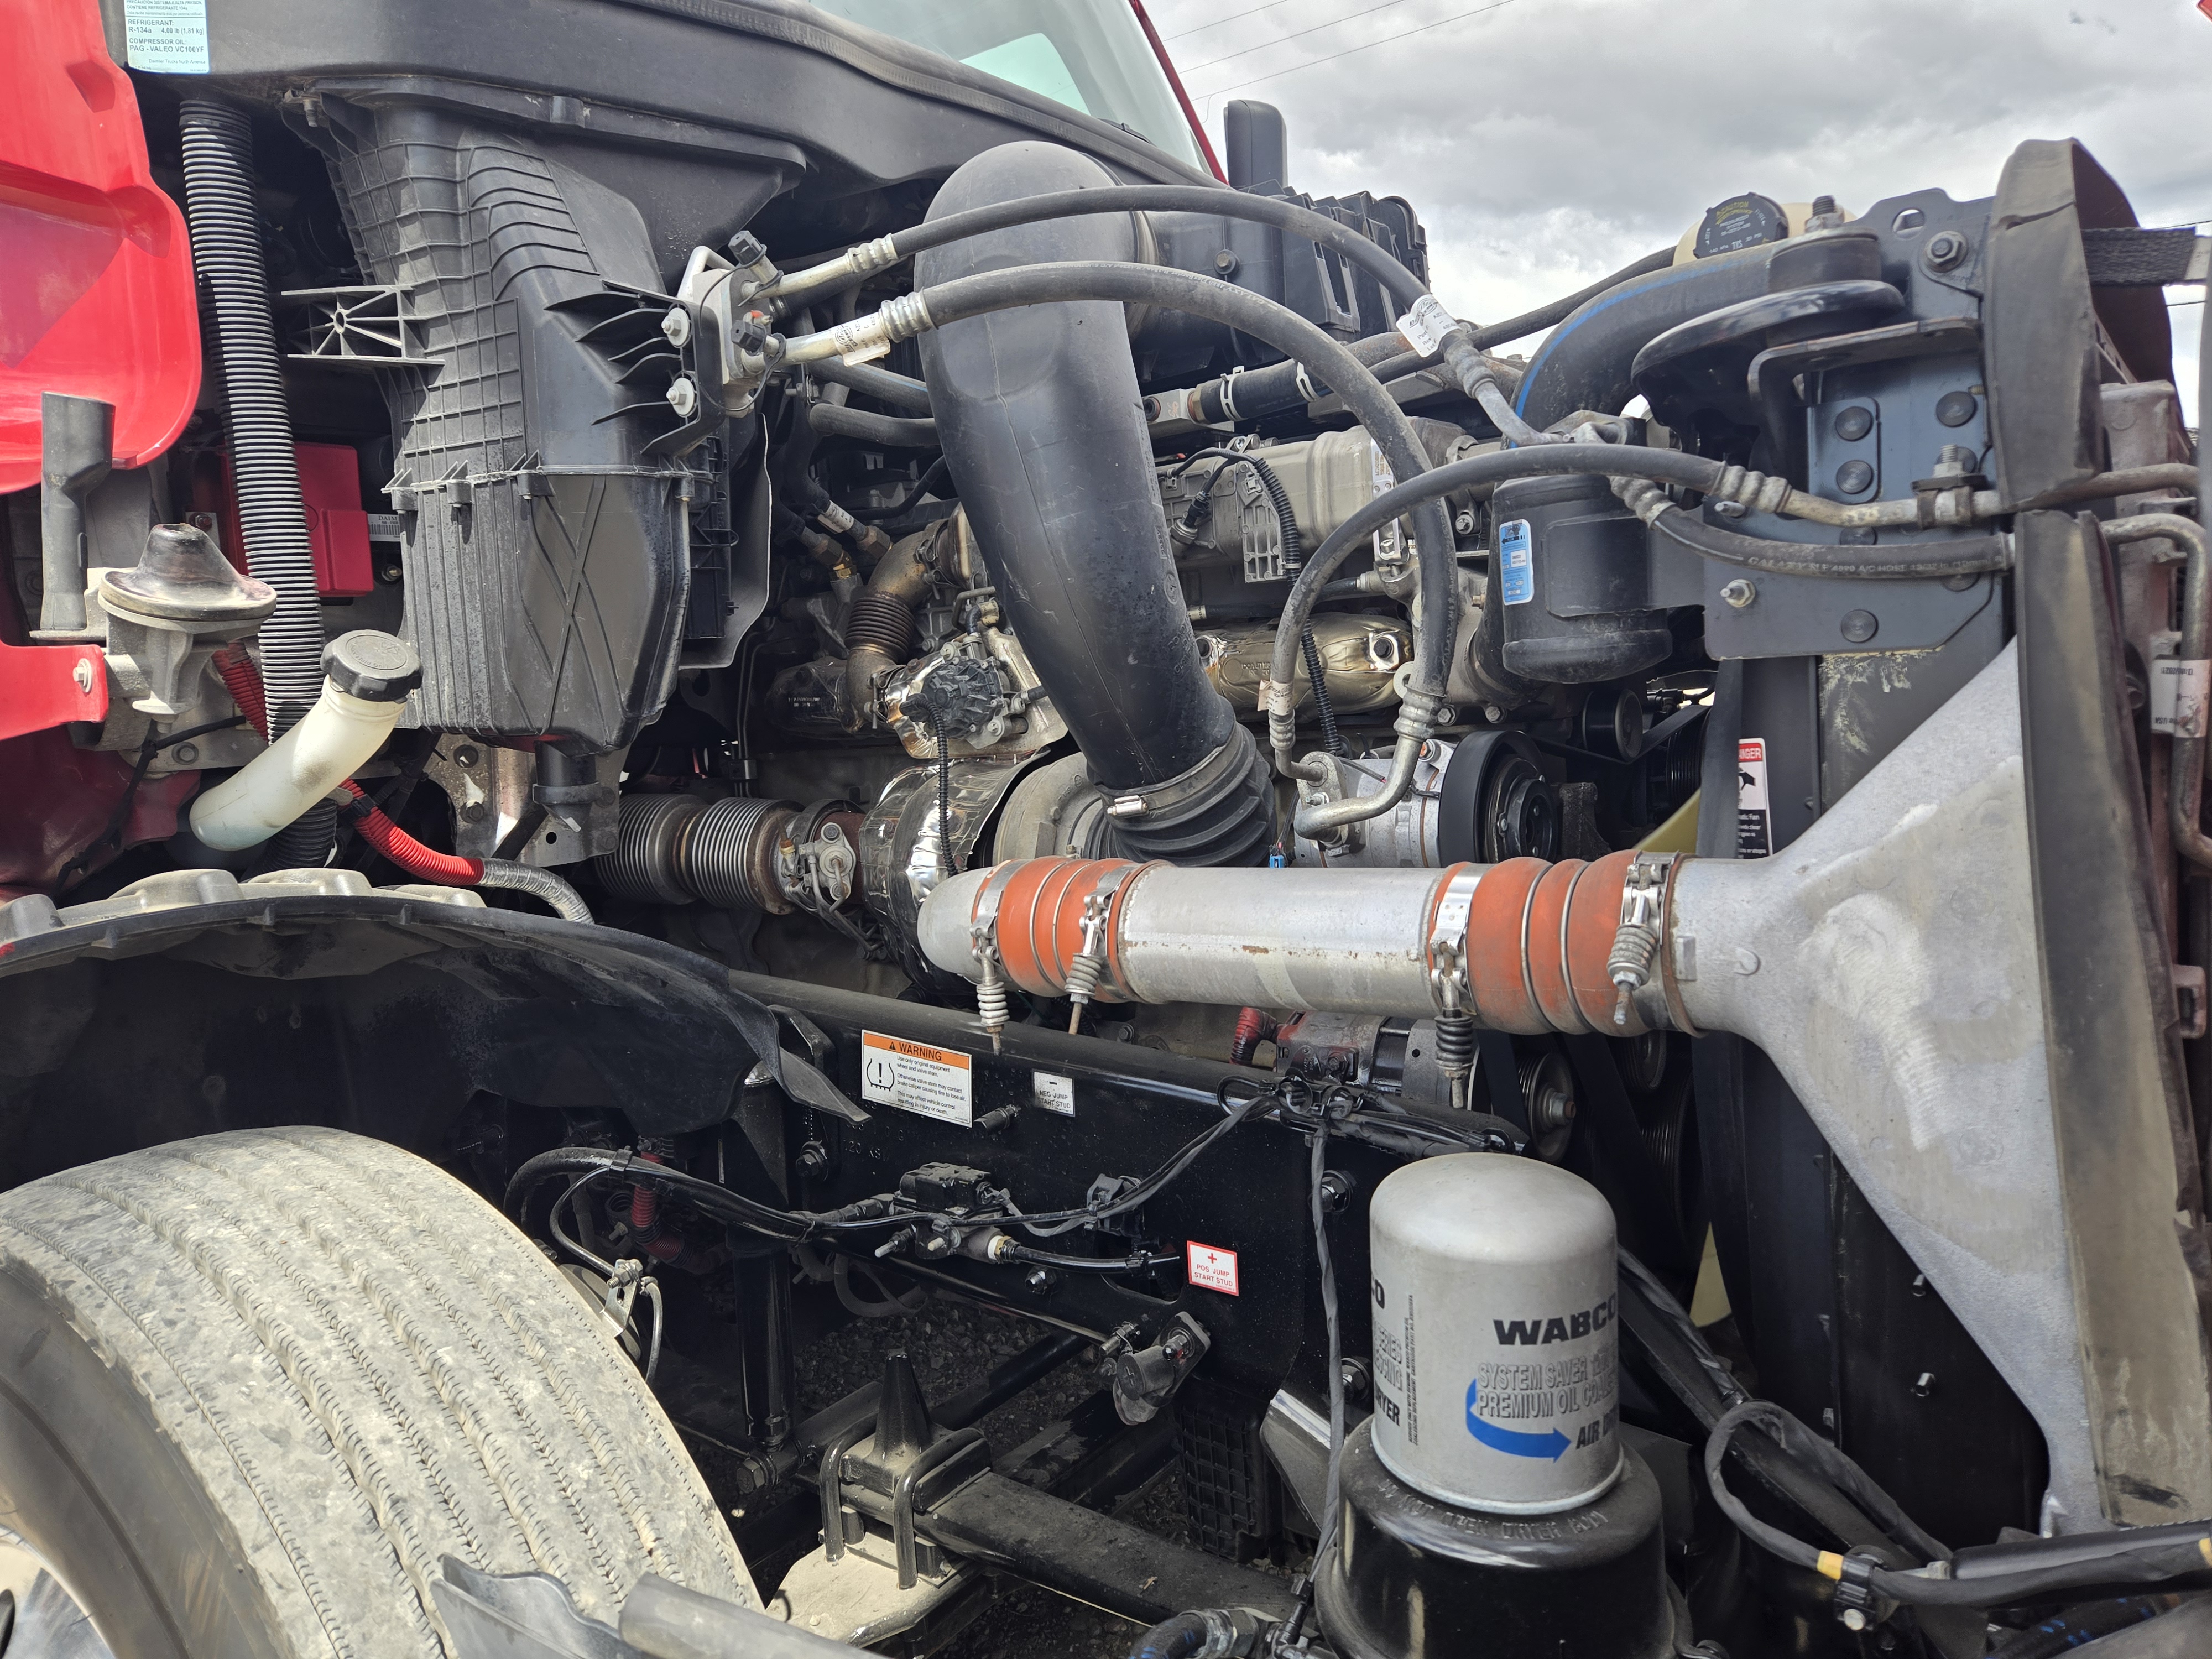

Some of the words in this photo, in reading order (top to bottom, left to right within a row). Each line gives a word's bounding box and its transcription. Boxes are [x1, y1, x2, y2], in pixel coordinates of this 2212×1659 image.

[1731, 240, 1743, 249] TVS
[1747, 557, 1808, 571] GALAXY
[1739, 748, 1761, 759] ANGER
[899, 1042, 942, 1061] WARNING
[929, 1063, 950, 1073] equipment
[897, 1073, 916, 1082] Otherwise
[922, 1087, 937, 1095] causing
[898, 1098, 914, 1107] resulting
[919, 1103, 931, 1112] injury
[1037, 1097, 1055, 1105] START
[1197, 1264, 1209, 1272] POS
[1194, 1272, 1214, 1282] START
[1216, 1277, 1233, 1286] STUD
[1477, 1362, 1542, 1391] SYSTEM
[1545, 1357, 1587, 1388] SAVER
[1477, 1390, 1554, 1419] PREMIUM
[1556, 1387, 1581, 1415] OIL
[1575, 1421, 1600, 1450] AIR
